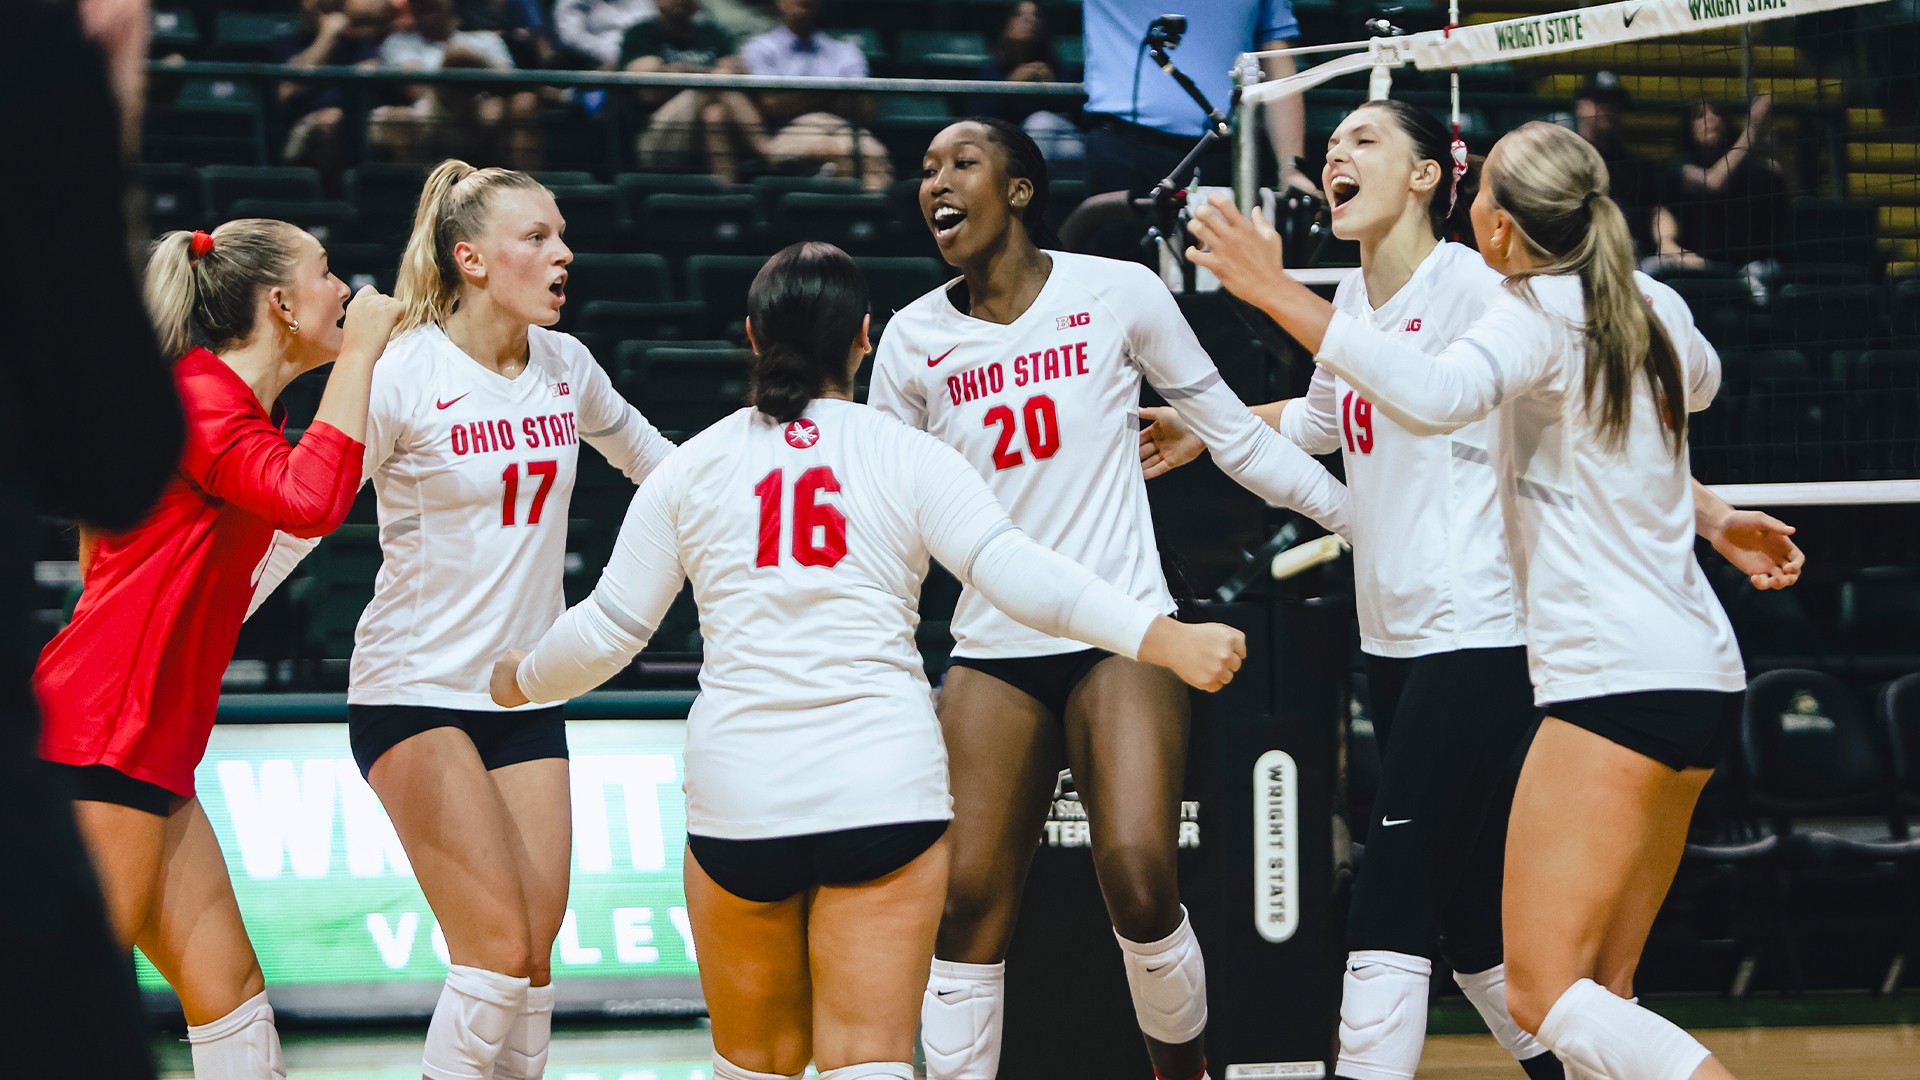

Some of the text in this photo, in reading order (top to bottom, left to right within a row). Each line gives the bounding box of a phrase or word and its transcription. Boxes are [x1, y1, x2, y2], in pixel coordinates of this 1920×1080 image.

[1494, 15, 1583, 51] WRIGHT STATE
[947, 341, 1089, 406] OHIO STATE
[451, 411, 577, 456] OHIO STATE
[983, 392, 1062, 472] 20
[1342, 390, 1374, 455] 19
[501, 458, 558, 528] 17
[753, 465, 849, 569] 16
[1268, 765, 1286, 923] WRIGHT STATE
